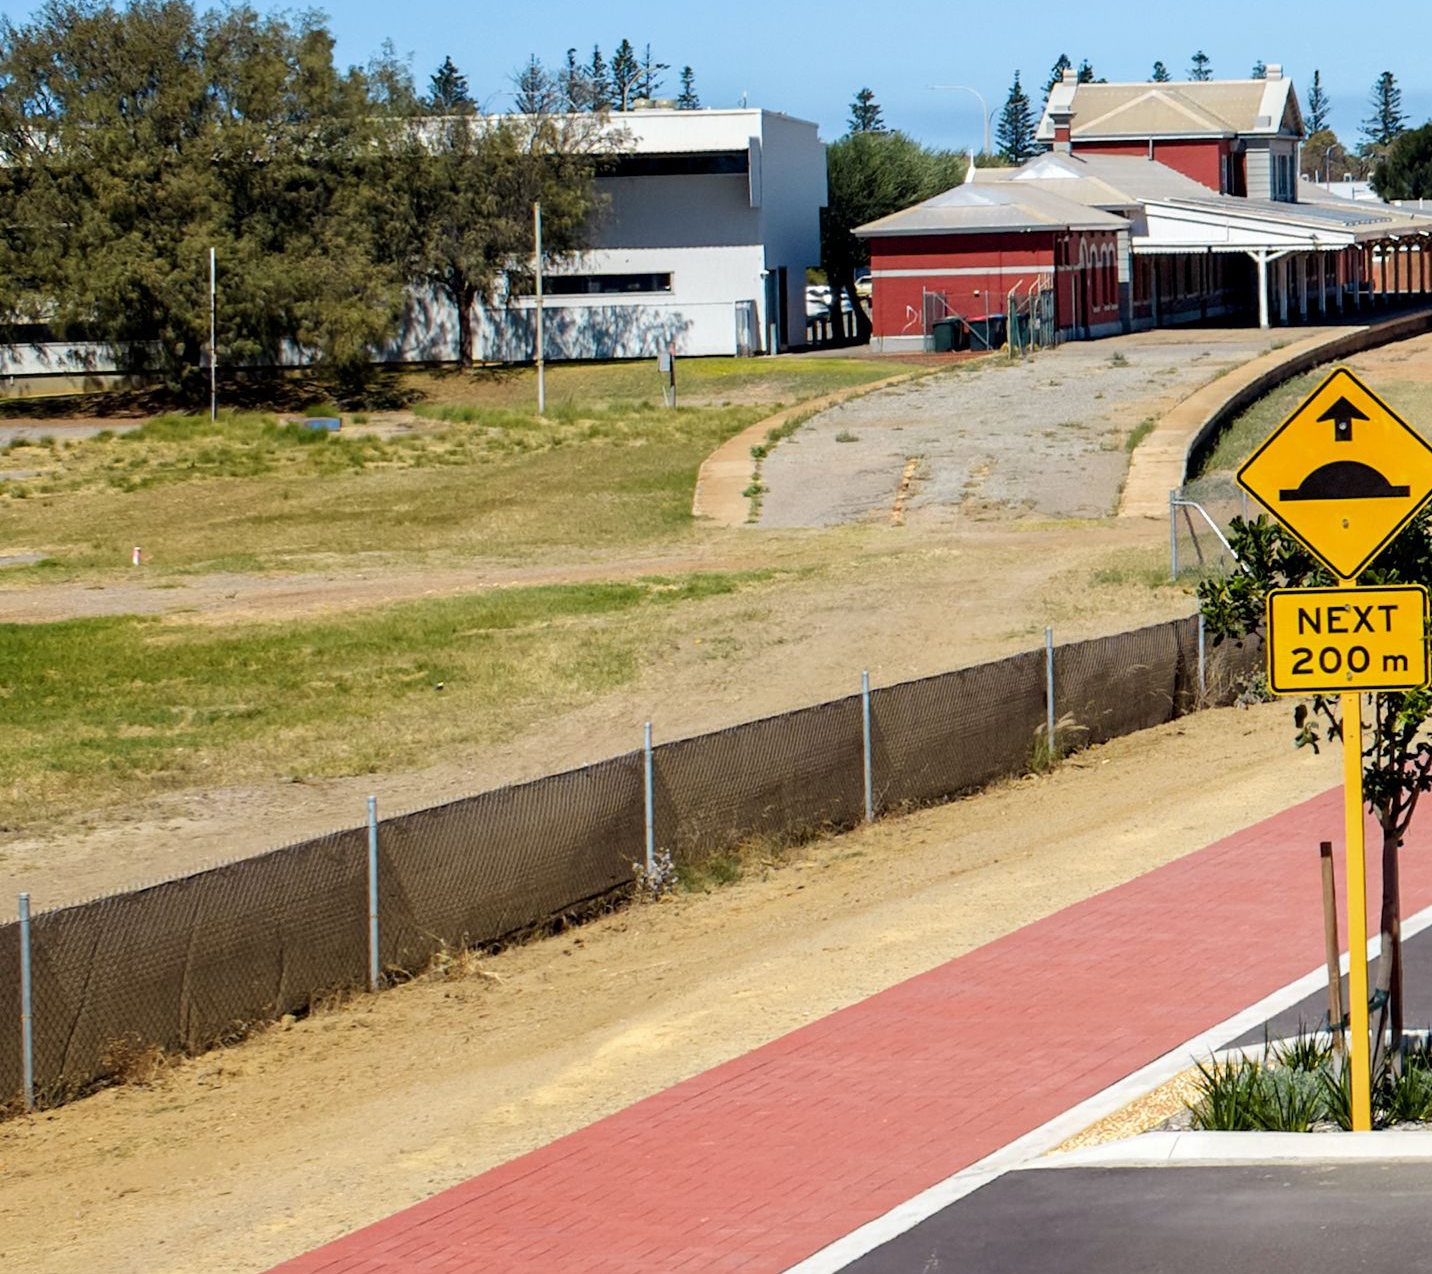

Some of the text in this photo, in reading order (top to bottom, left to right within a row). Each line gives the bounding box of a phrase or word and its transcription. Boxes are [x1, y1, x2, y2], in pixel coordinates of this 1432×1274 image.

[1298, 605, 1399, 634] NEXT
[1291, 645, 1408, 675] 200 m
